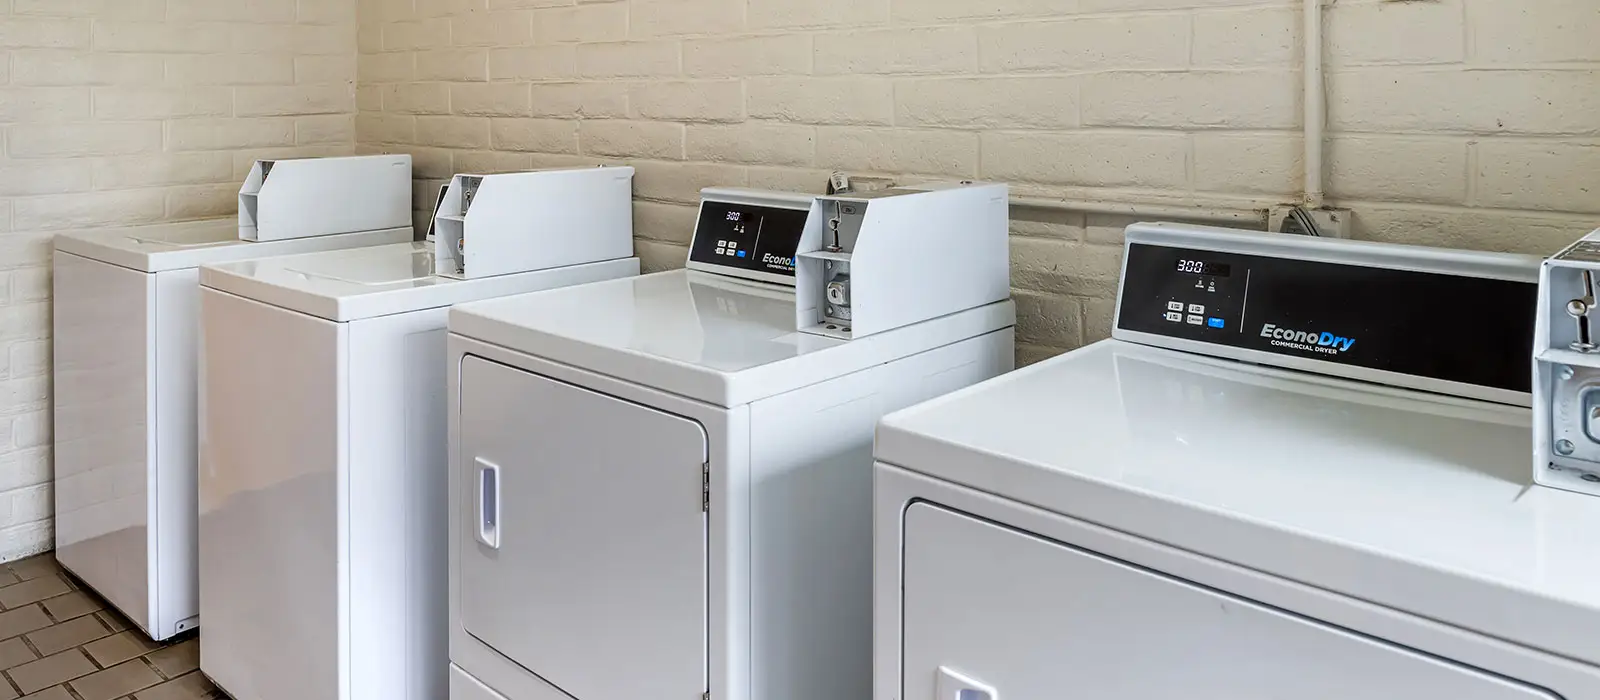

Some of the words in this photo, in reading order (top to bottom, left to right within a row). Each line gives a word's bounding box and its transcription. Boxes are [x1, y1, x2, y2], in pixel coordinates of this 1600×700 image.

[1177, 259, 1203, 273] 300
[1260, 323, 1356, 352] EconoDry
[1270, 339, 1314, 352] COMMERCIAL
[1314, 346, 1338, 355] DRYER
